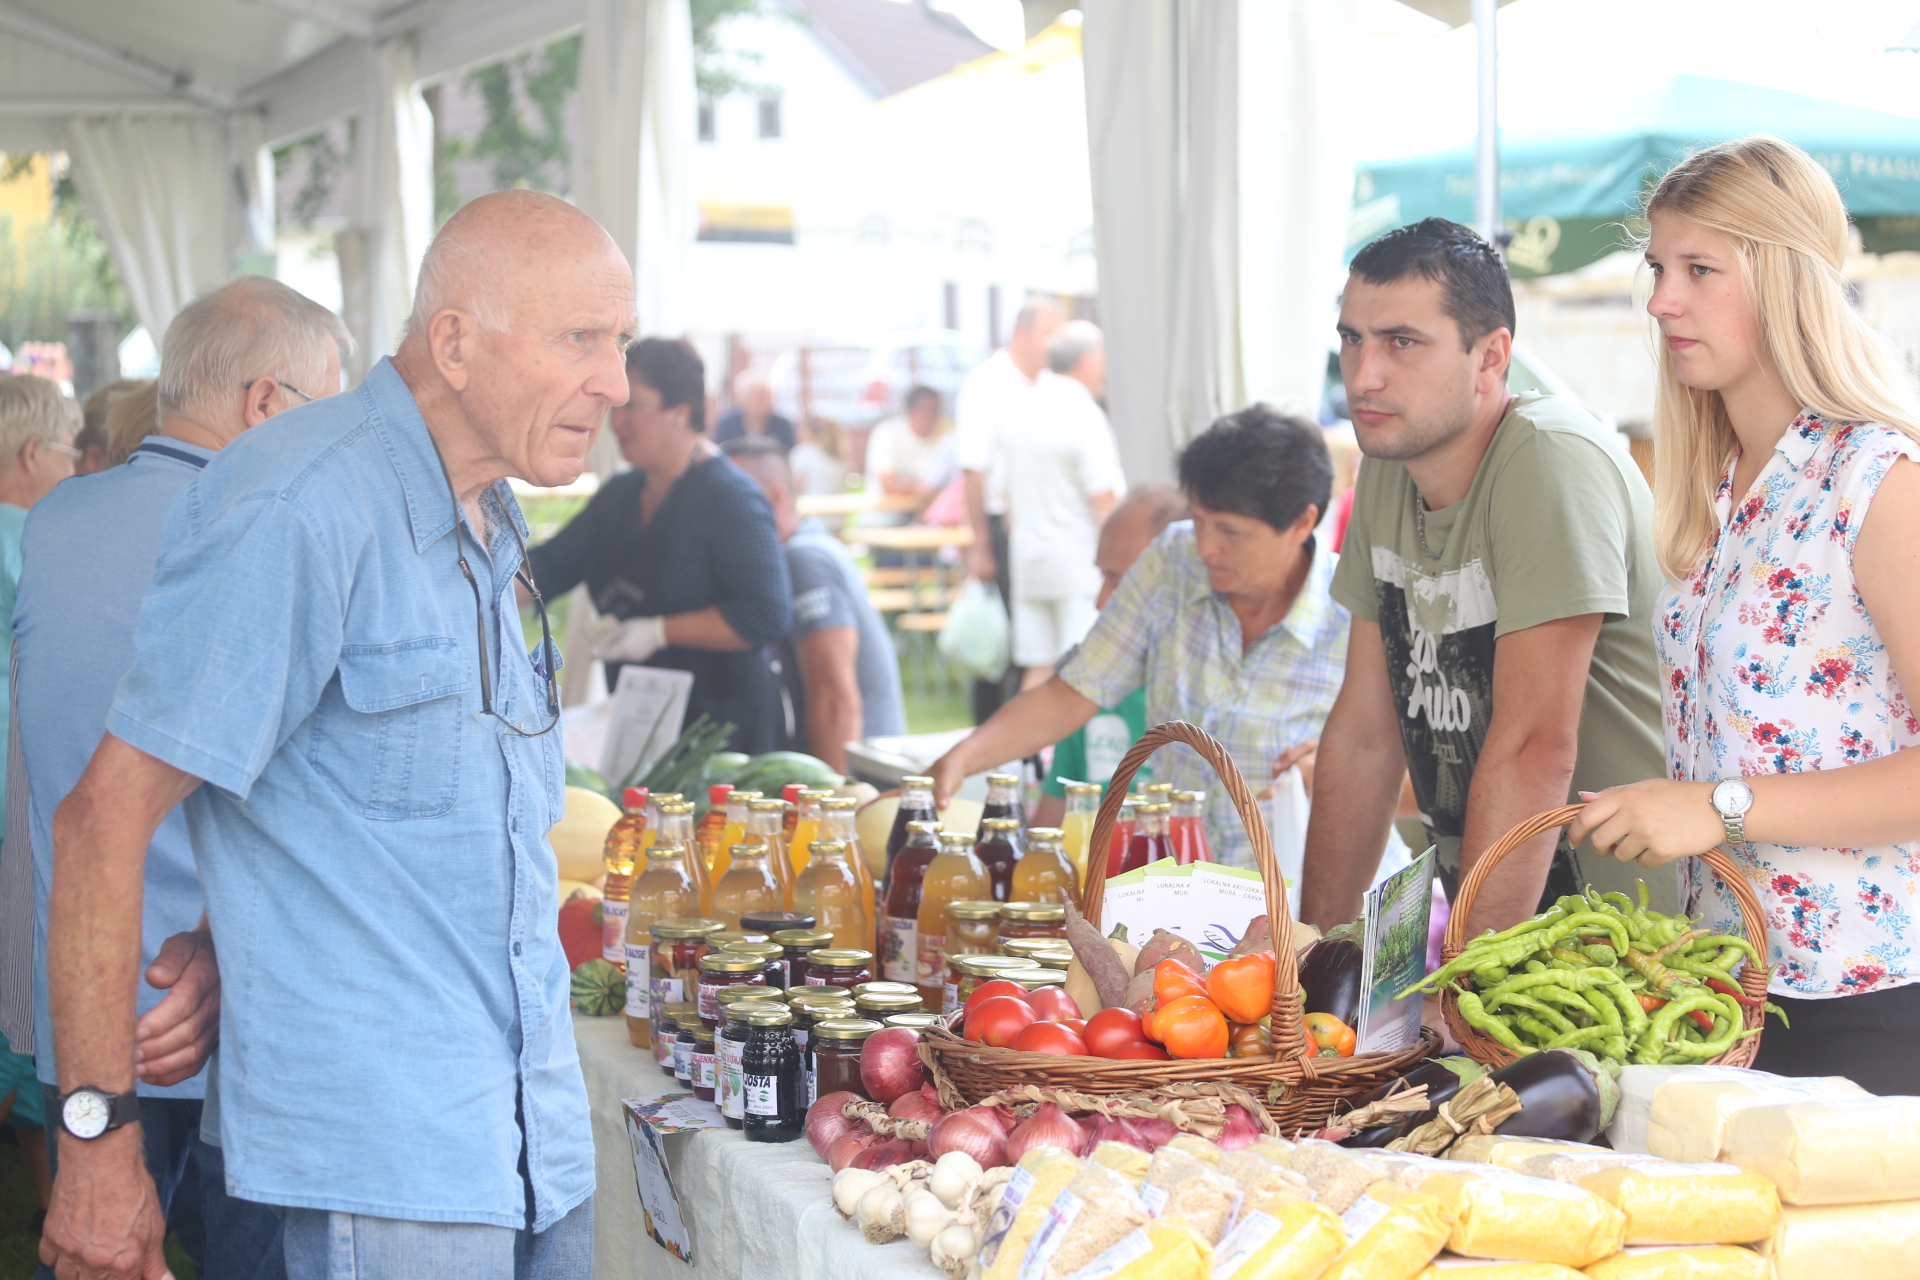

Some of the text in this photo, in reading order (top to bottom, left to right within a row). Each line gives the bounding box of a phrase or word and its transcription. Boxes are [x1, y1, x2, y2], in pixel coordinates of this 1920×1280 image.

[1203, 878, 1231, 888] LOKALNA
[1231, 883, 1260, 894] AKCIJSKA
[1242, 893, 1262, 902] DRAVA
[744, 1074, 770, 1088] JOSTA
